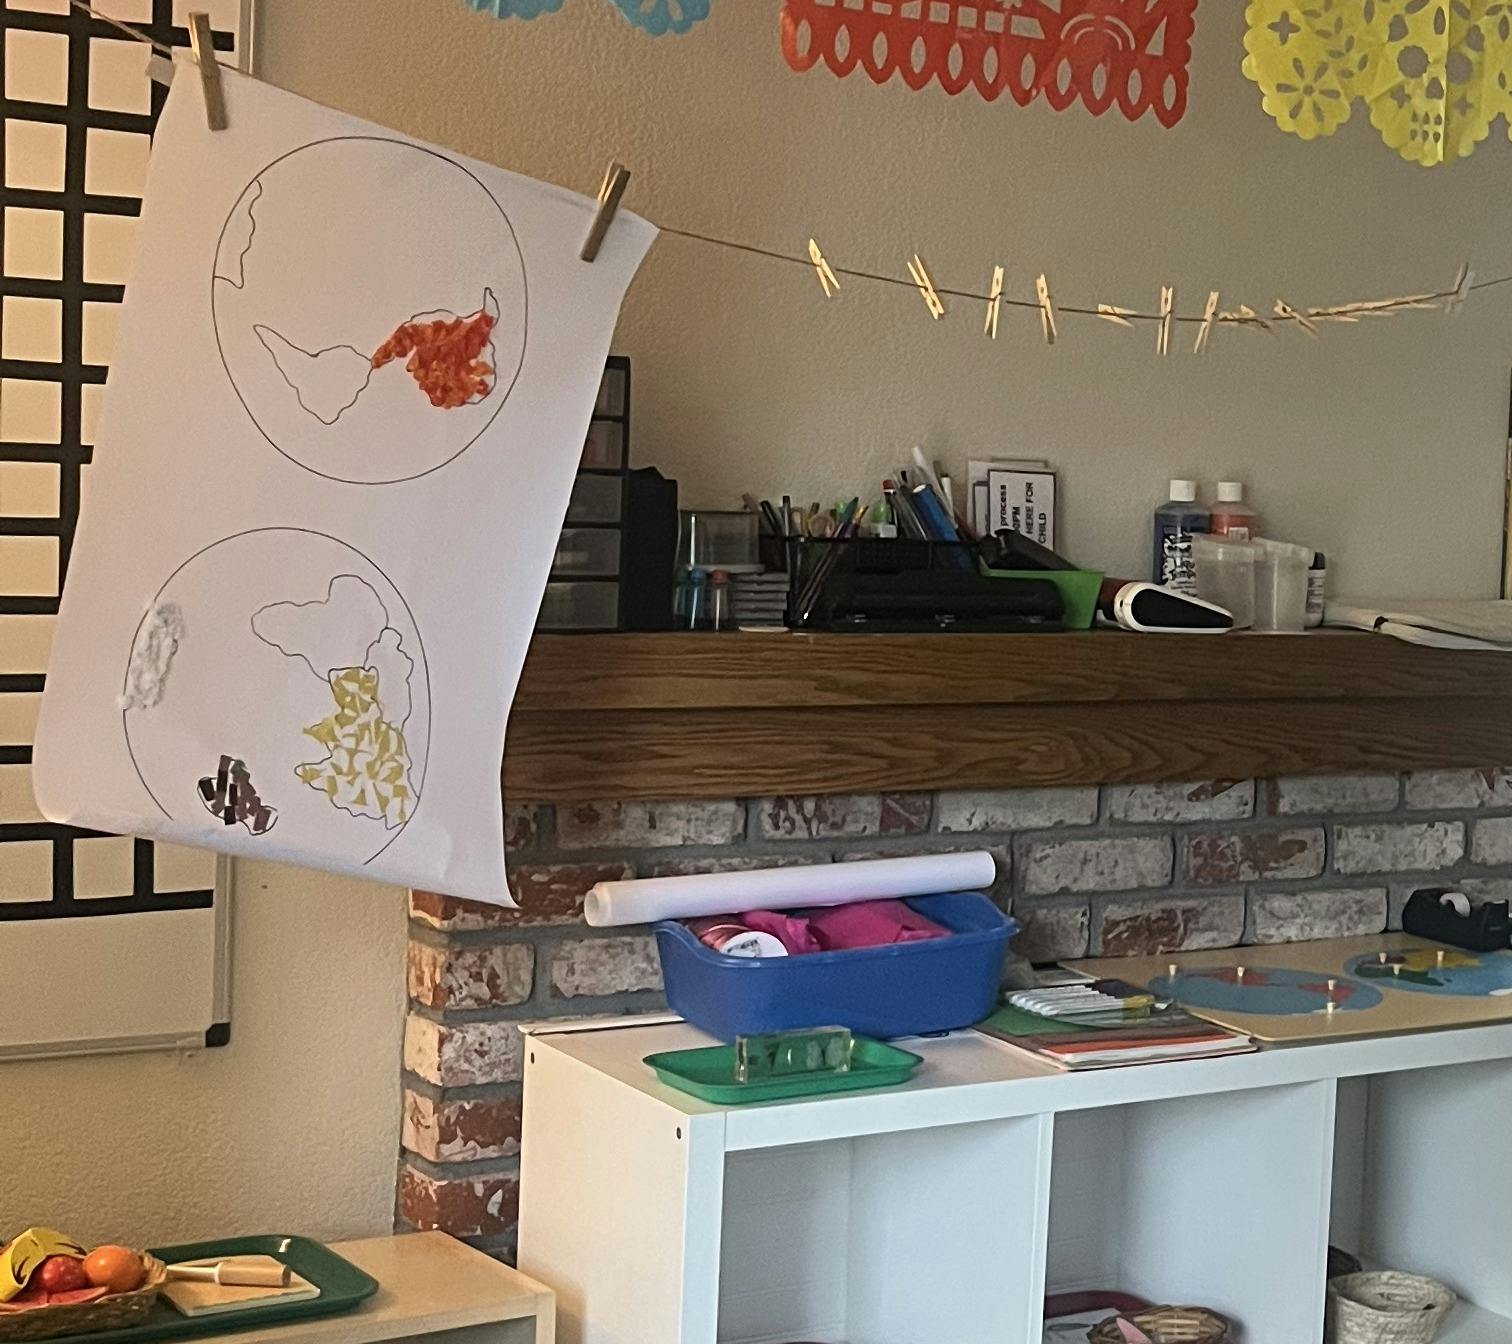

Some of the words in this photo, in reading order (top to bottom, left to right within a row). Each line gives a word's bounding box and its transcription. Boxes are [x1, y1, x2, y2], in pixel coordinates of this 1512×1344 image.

[1000, 484, 1009, 527] process
[1025, 482, 1034, 504] FOR
[1038, 512, 1047, 544] CHILD
